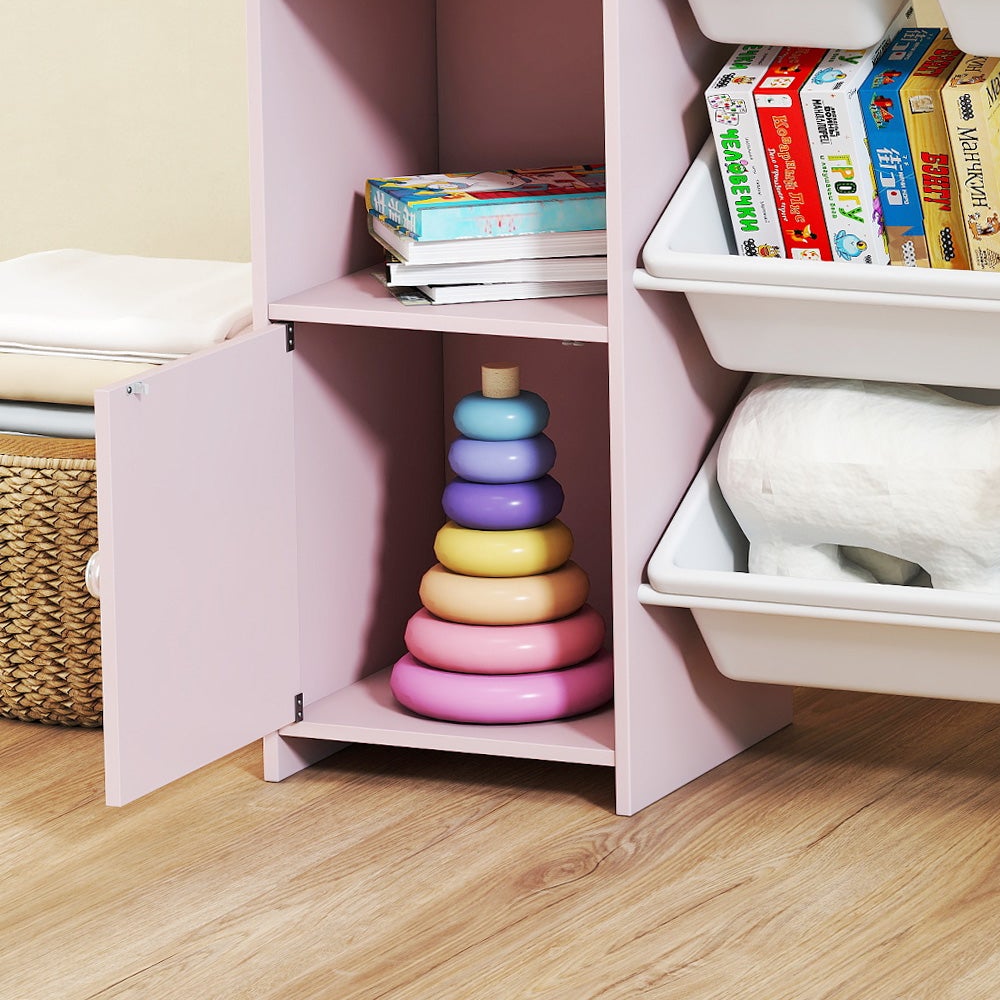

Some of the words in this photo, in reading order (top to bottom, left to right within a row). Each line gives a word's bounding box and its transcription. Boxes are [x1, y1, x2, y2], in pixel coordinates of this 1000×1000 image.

[812, 99, 830, 144] МАНДАЛОРЕЦ
[824, 106, 836, 137] ВОЙНЫ
[719, 128, 759, 233] ЧЕЛОВЕЧКИ
[772, 115, 798, 190] Коварный
[790, 192, 806, 223] Лис
[827, 155, 865, 223] ГРОГУ
[920, 151, 952, 212] БЭНГ!
[957, 127, 988, 208] Манчкин
